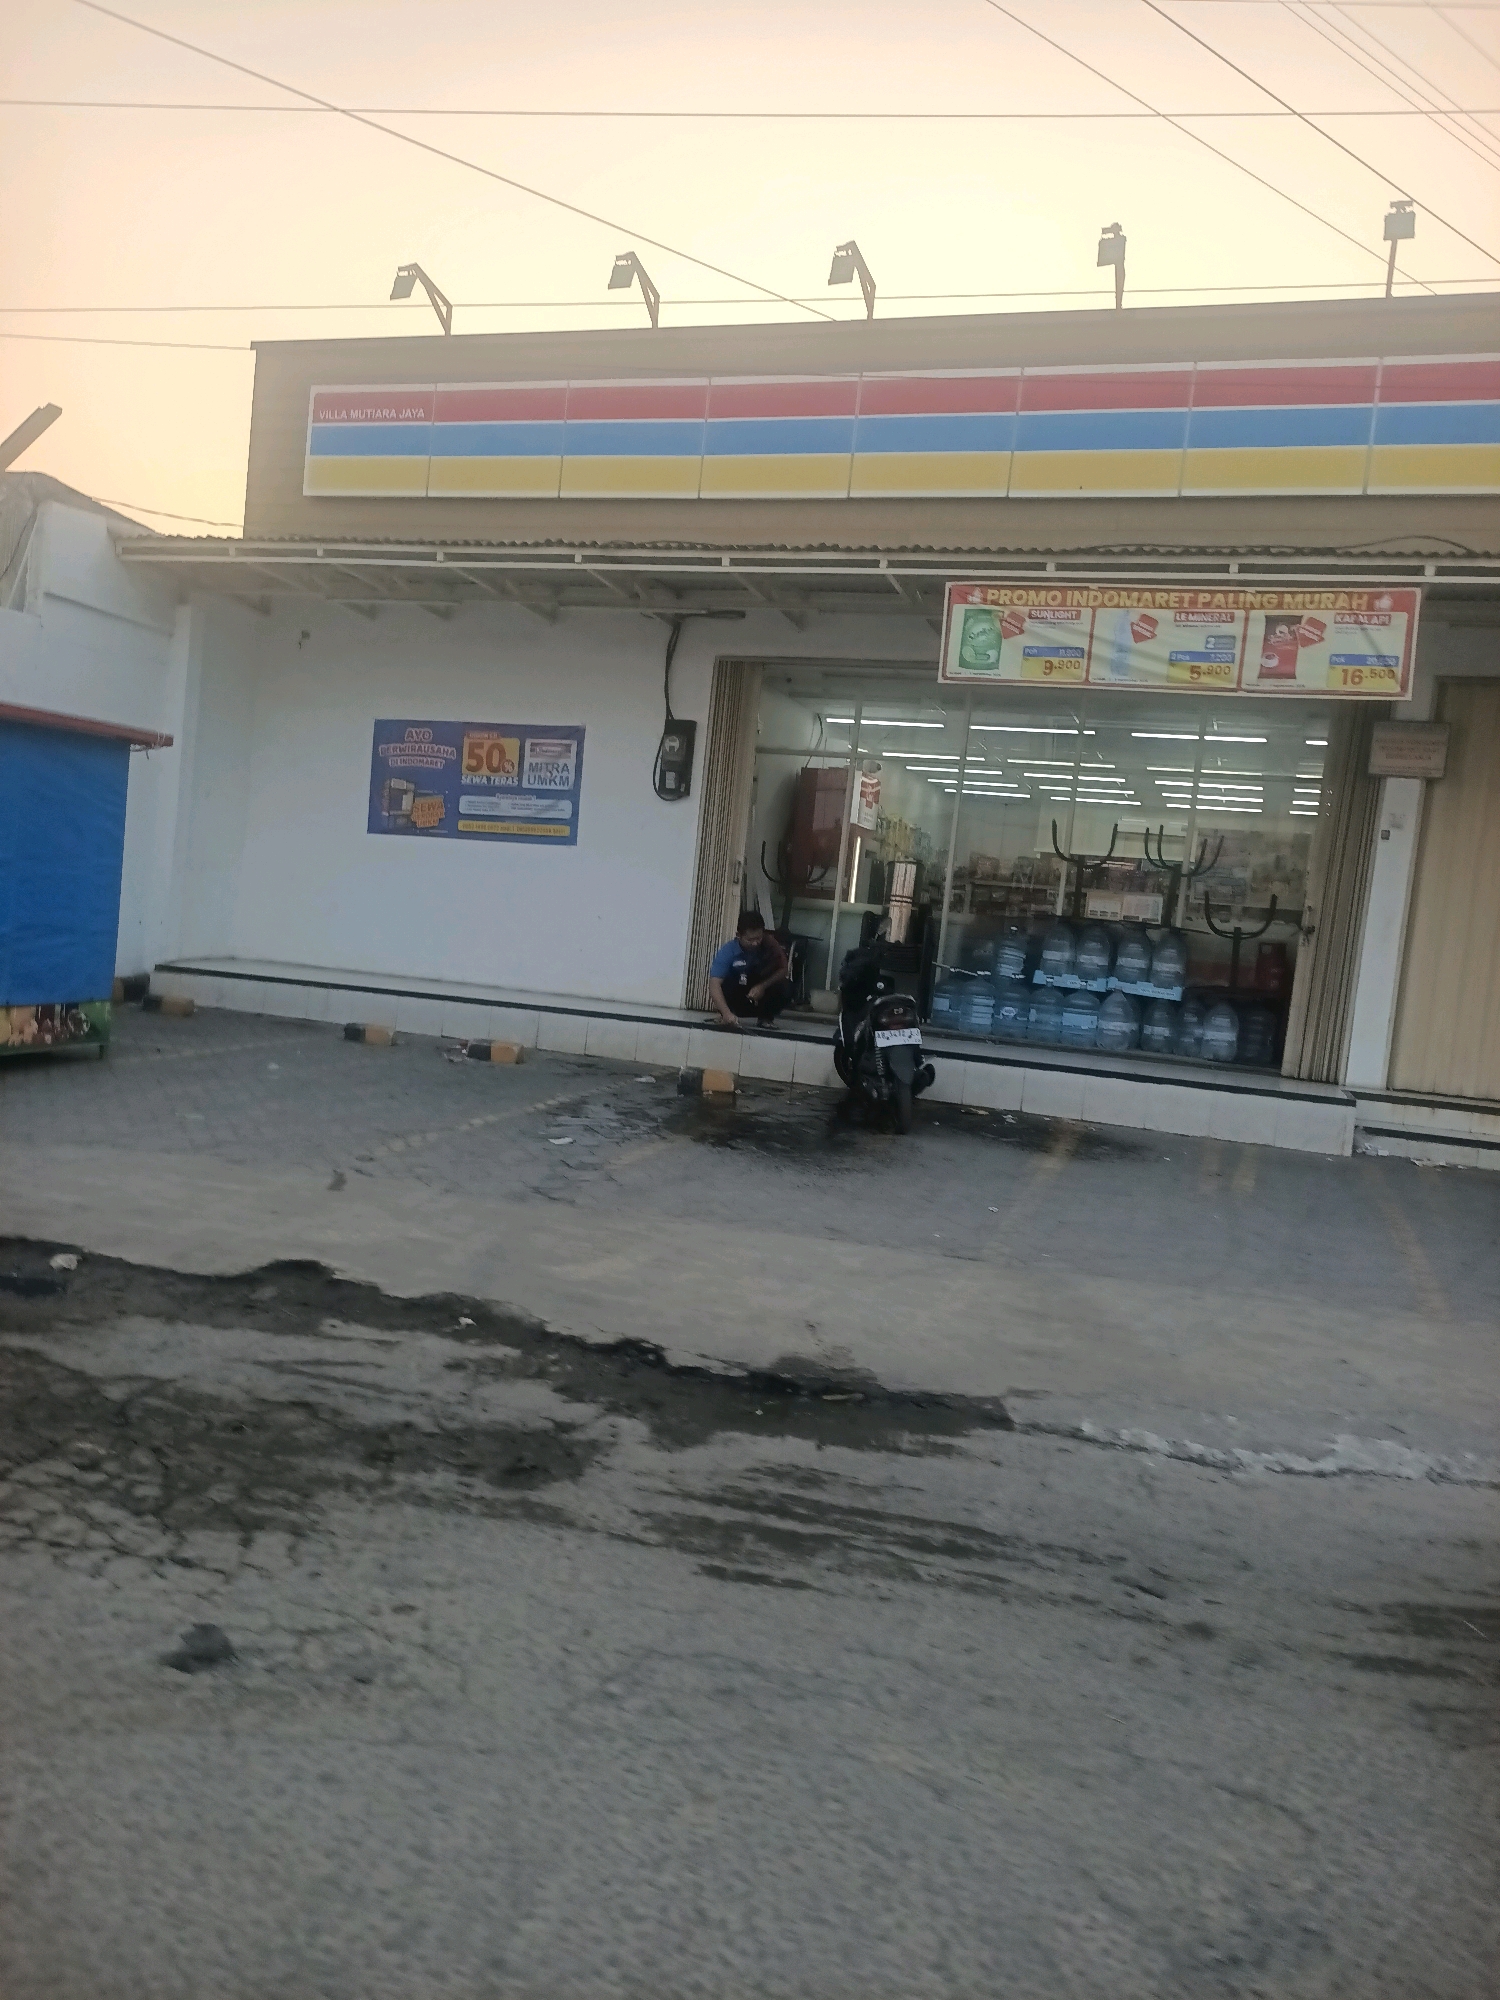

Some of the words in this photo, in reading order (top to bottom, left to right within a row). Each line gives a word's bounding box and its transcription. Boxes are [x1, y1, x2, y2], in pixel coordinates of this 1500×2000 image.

[319, 409, 347, 420] VILLA
[350, 409, 397, 420] MUTIARA
[399, 408, 425, 419] JAYA
[986, 588, 1062, 606] PROMO
[1065, 589, 1194, 608] INDOMARET
[1197, 592, 1279, 610] PALING
[1282, 592, 1369, 611] MURAH
[1031, 609, 1078, 620] SUNLIGHT
[1042, 660, 1081, 676] 9.900
[1189, 665, 1232, 681] 5.900
[1341, 668, 1397, 686] 16.500
[405, 728, 433, 742] AYO
[528, 761, 570, 773] MITRA
[461, 775, 488, 785] SEWA
[489, 776, 519, 787] TERAS
[526, 773, 570, 787] UMKM
